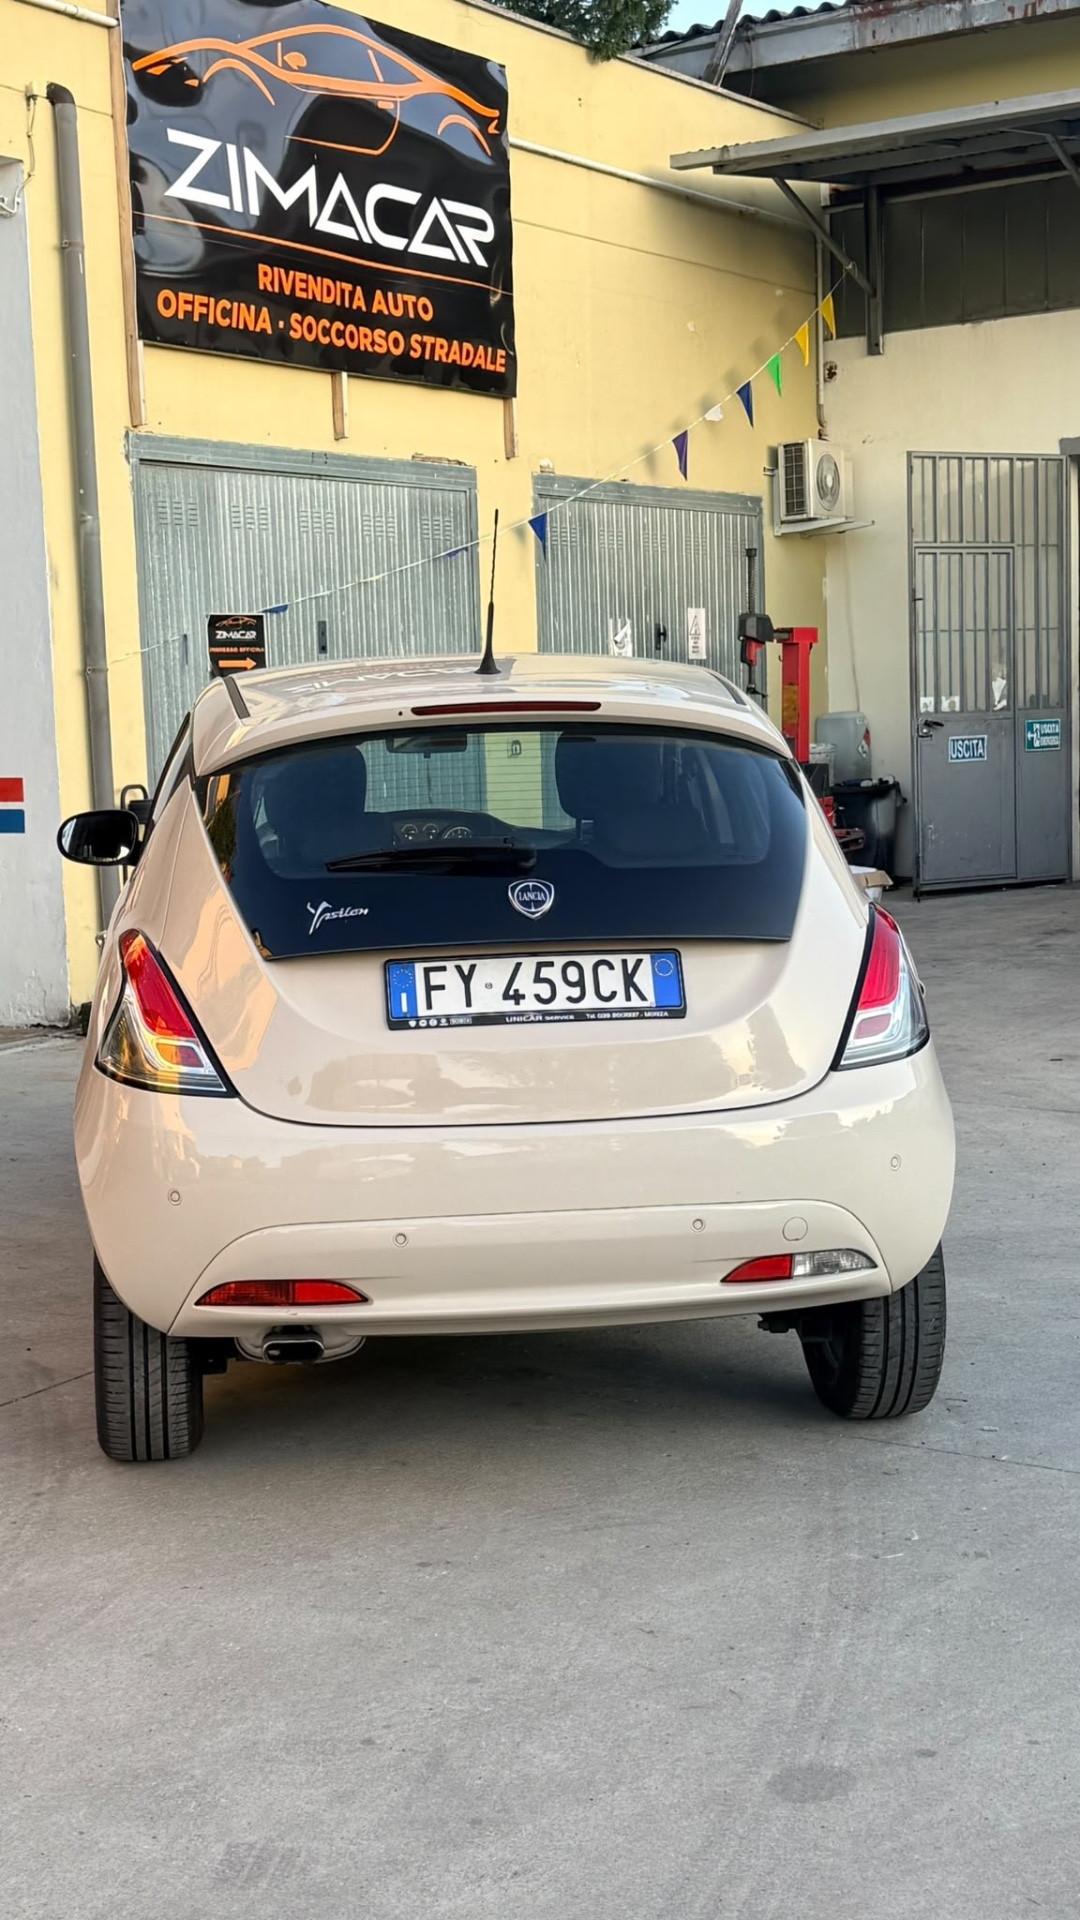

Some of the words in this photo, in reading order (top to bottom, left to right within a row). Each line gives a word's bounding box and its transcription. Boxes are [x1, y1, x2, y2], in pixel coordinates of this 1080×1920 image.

[164, 127, 495, 268] ZIMACAR
[257, 262, 364, 312] RIVENDITA
[371, 289, 434, 322] AUTO
[156, 288, 272, 335] OFFICINA
[289, 312, 405, 358] SOCCORSO
[409, 333, 507, 374] STRADALE
[215, 630, 257, 639] ZIMACAR
[950, 739, 985, 758] USCITA
[518, 891, 546, 901] LANCIA
[307, 900, 369, 935] Ypsilon
[422, 962, 478, 1010] FY
[501, 957, 648, 1006] 459CK
[505, 1014, 543, 1023] UNICAR
